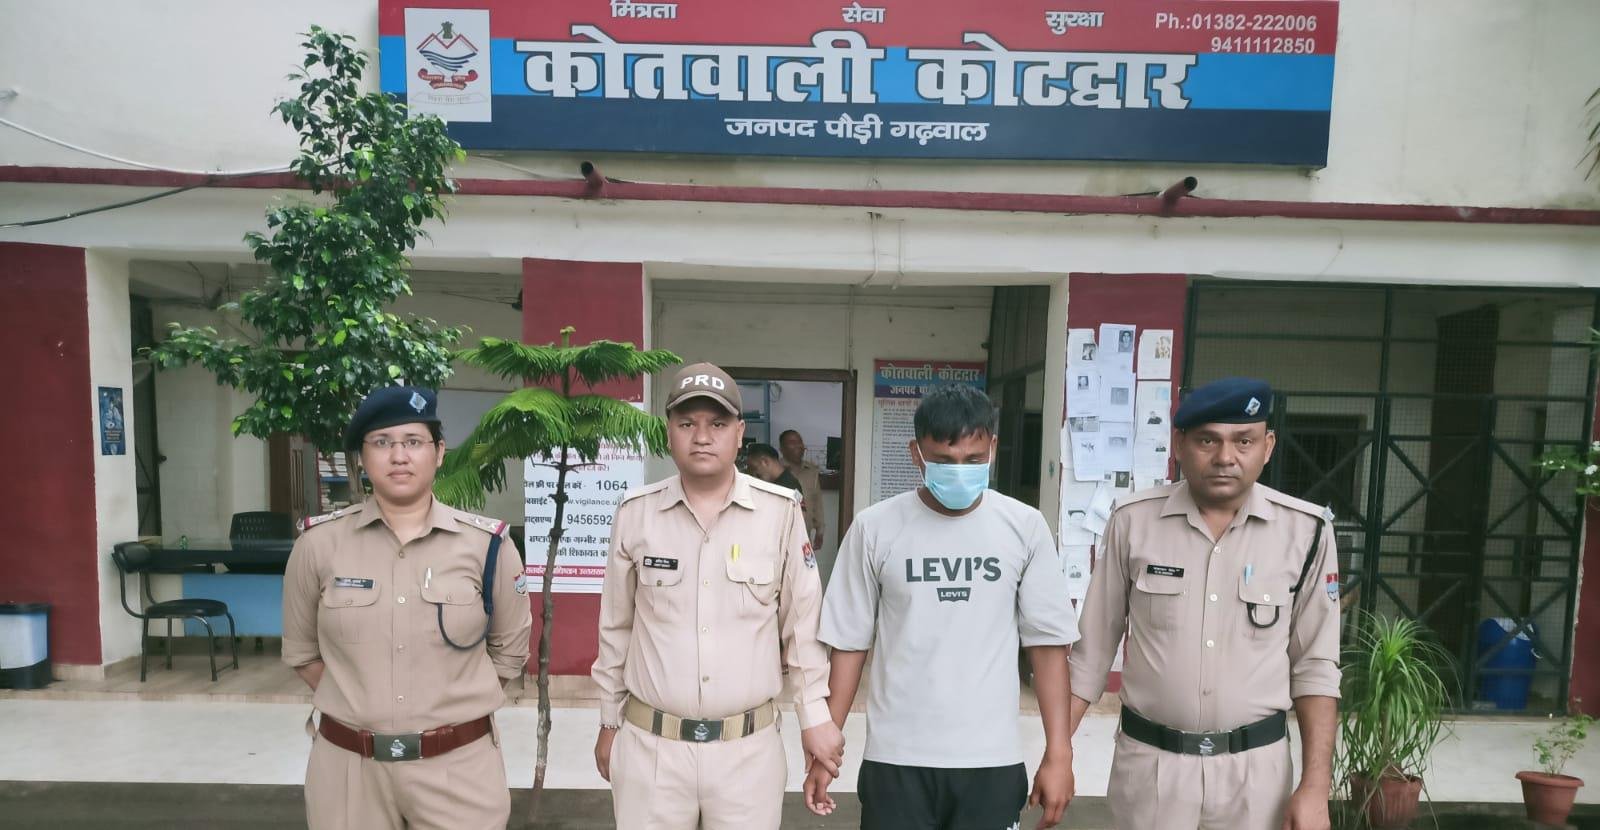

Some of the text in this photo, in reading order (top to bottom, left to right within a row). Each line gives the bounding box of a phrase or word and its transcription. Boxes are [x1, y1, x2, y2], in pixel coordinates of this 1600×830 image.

[610, 0, 678, 19] मित्रता
[841, 2, 886, 23] सेवा
[1045, 11, 1105, 35] सुरक्षा
[1155, 12, 1317, 32] Ph.:01382-222006
[1211, 37, 1315, 54] 9411112850
[515, 24, 1198, 109] कोतवाली कोटद्वार
[724, 113, 990, 146] जनपद पौड़ी गढ़वाल
[880, 363, 933, 380] कोतवाली
[680, 374, 725, 391] PRD
[890, 385, 916, 394] जनपद
[596, 479, 628, 491] 1064
[905, 557, 1002, 582] LEVI'S
